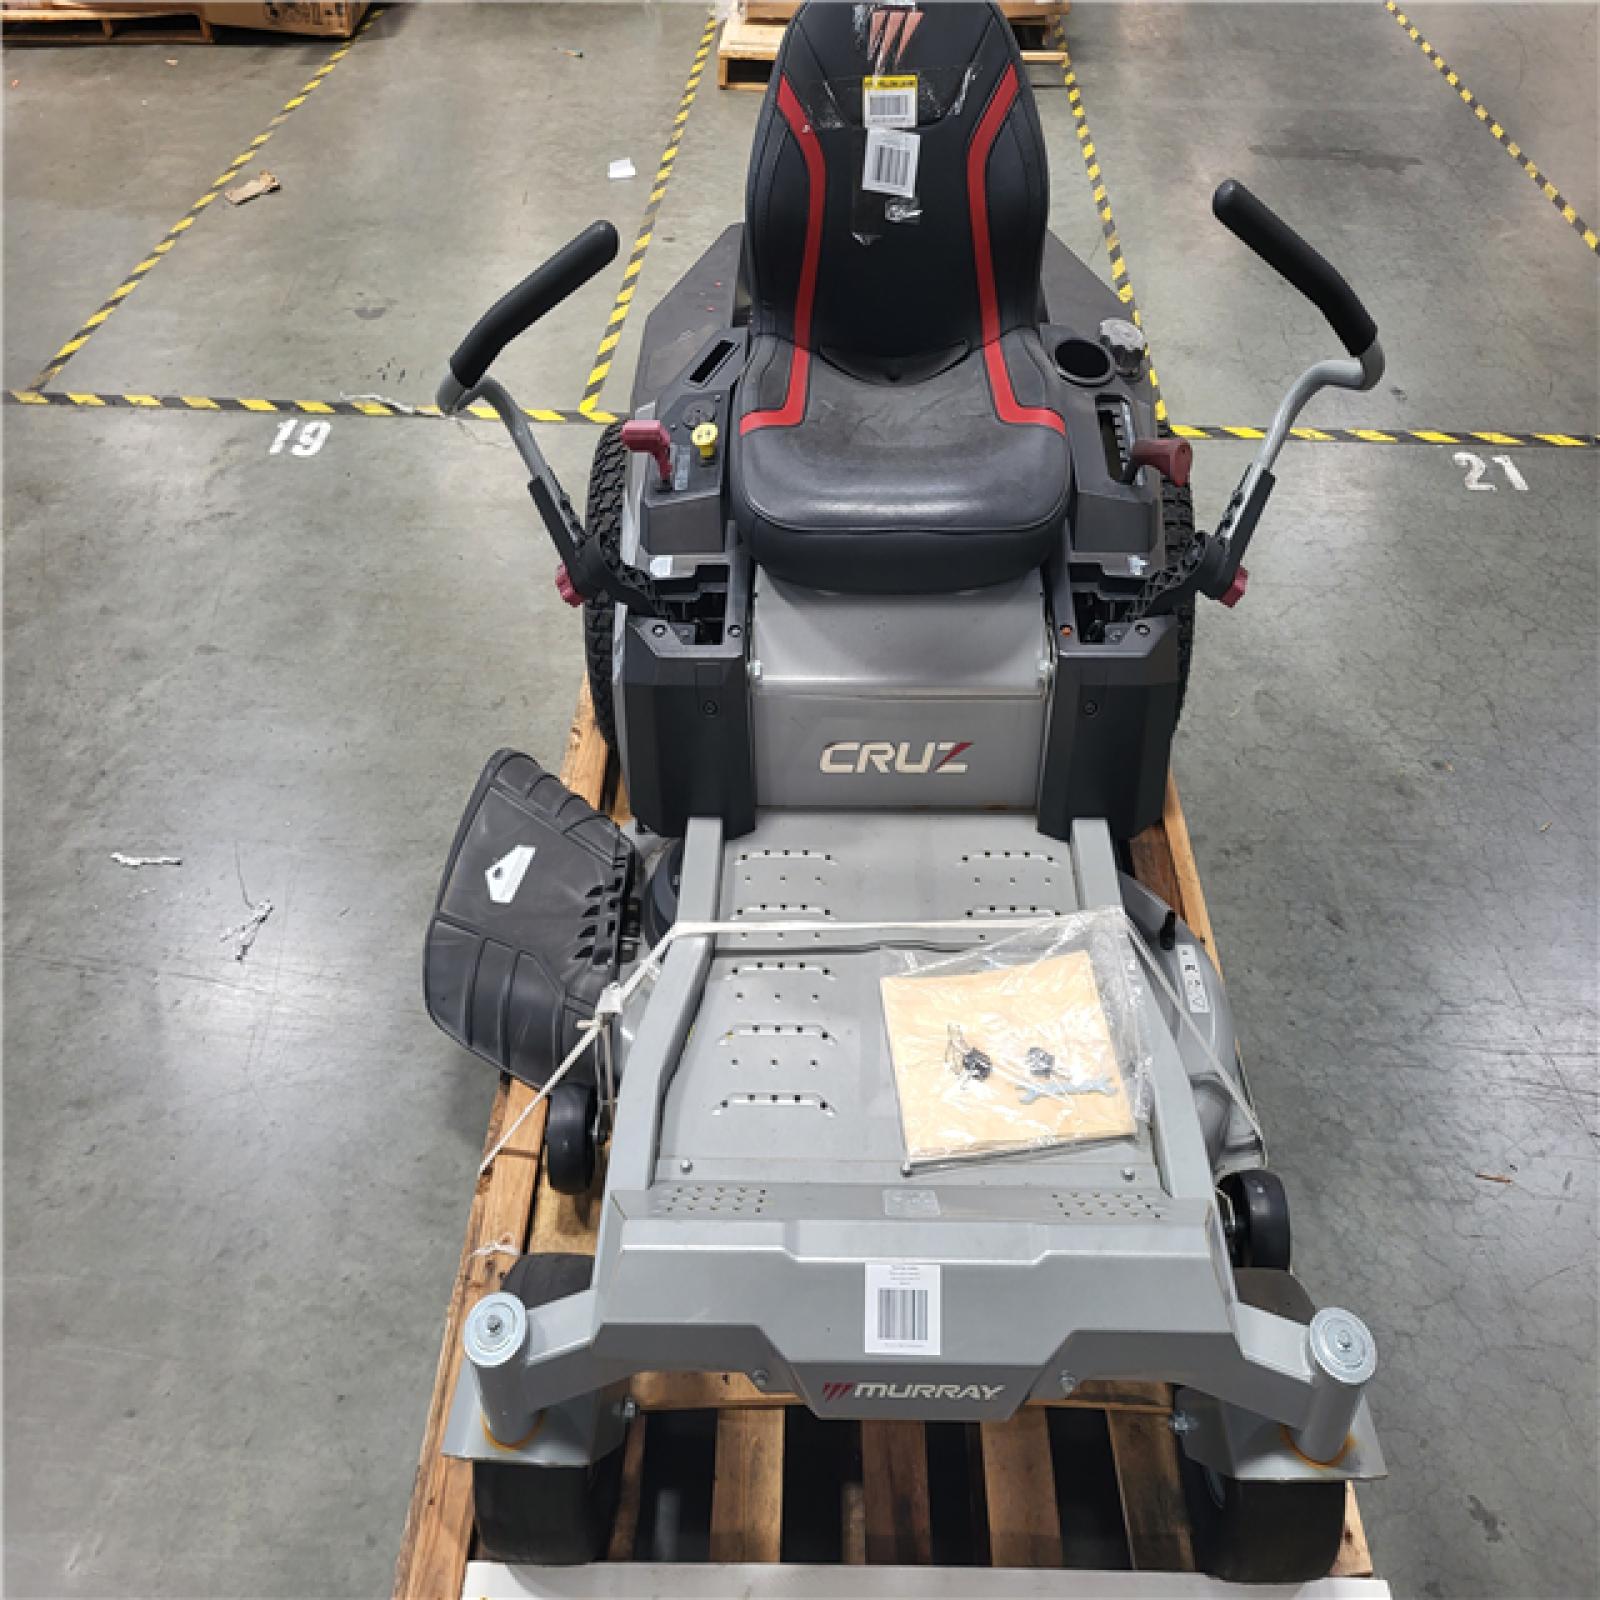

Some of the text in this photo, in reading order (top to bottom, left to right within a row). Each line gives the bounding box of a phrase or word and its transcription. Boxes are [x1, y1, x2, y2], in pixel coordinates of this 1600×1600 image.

[269, 418, 331, 456] 19
[1453, 452, 1529, 492] 21
[820, 741, 973, 774] CRUZ
[854, 1382, 1005, 1401] MURRAY
